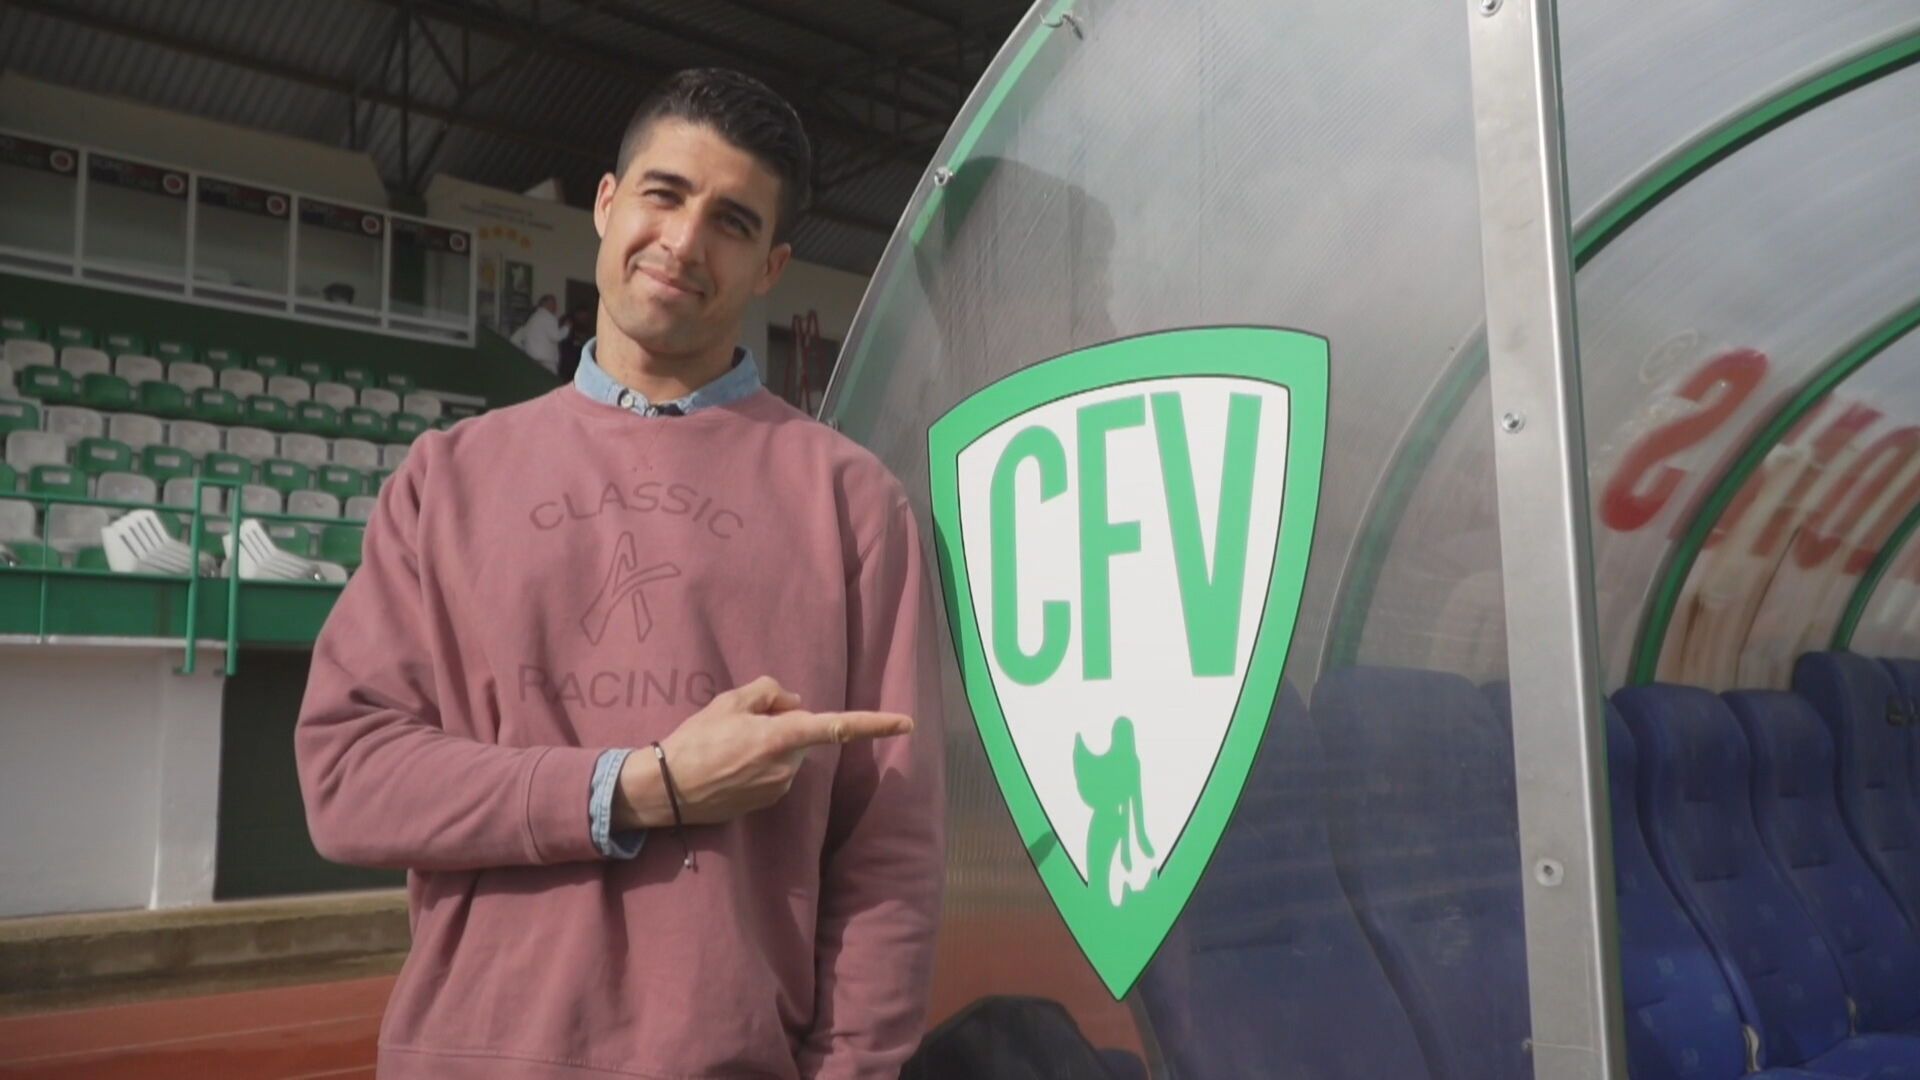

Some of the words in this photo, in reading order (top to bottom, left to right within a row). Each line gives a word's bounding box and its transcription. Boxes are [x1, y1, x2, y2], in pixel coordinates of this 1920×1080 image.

[528, 481, 745, 540] CLASSIC
[989, 391, 1263, 687] CFV
[517, 664, 718, 709] RACING
